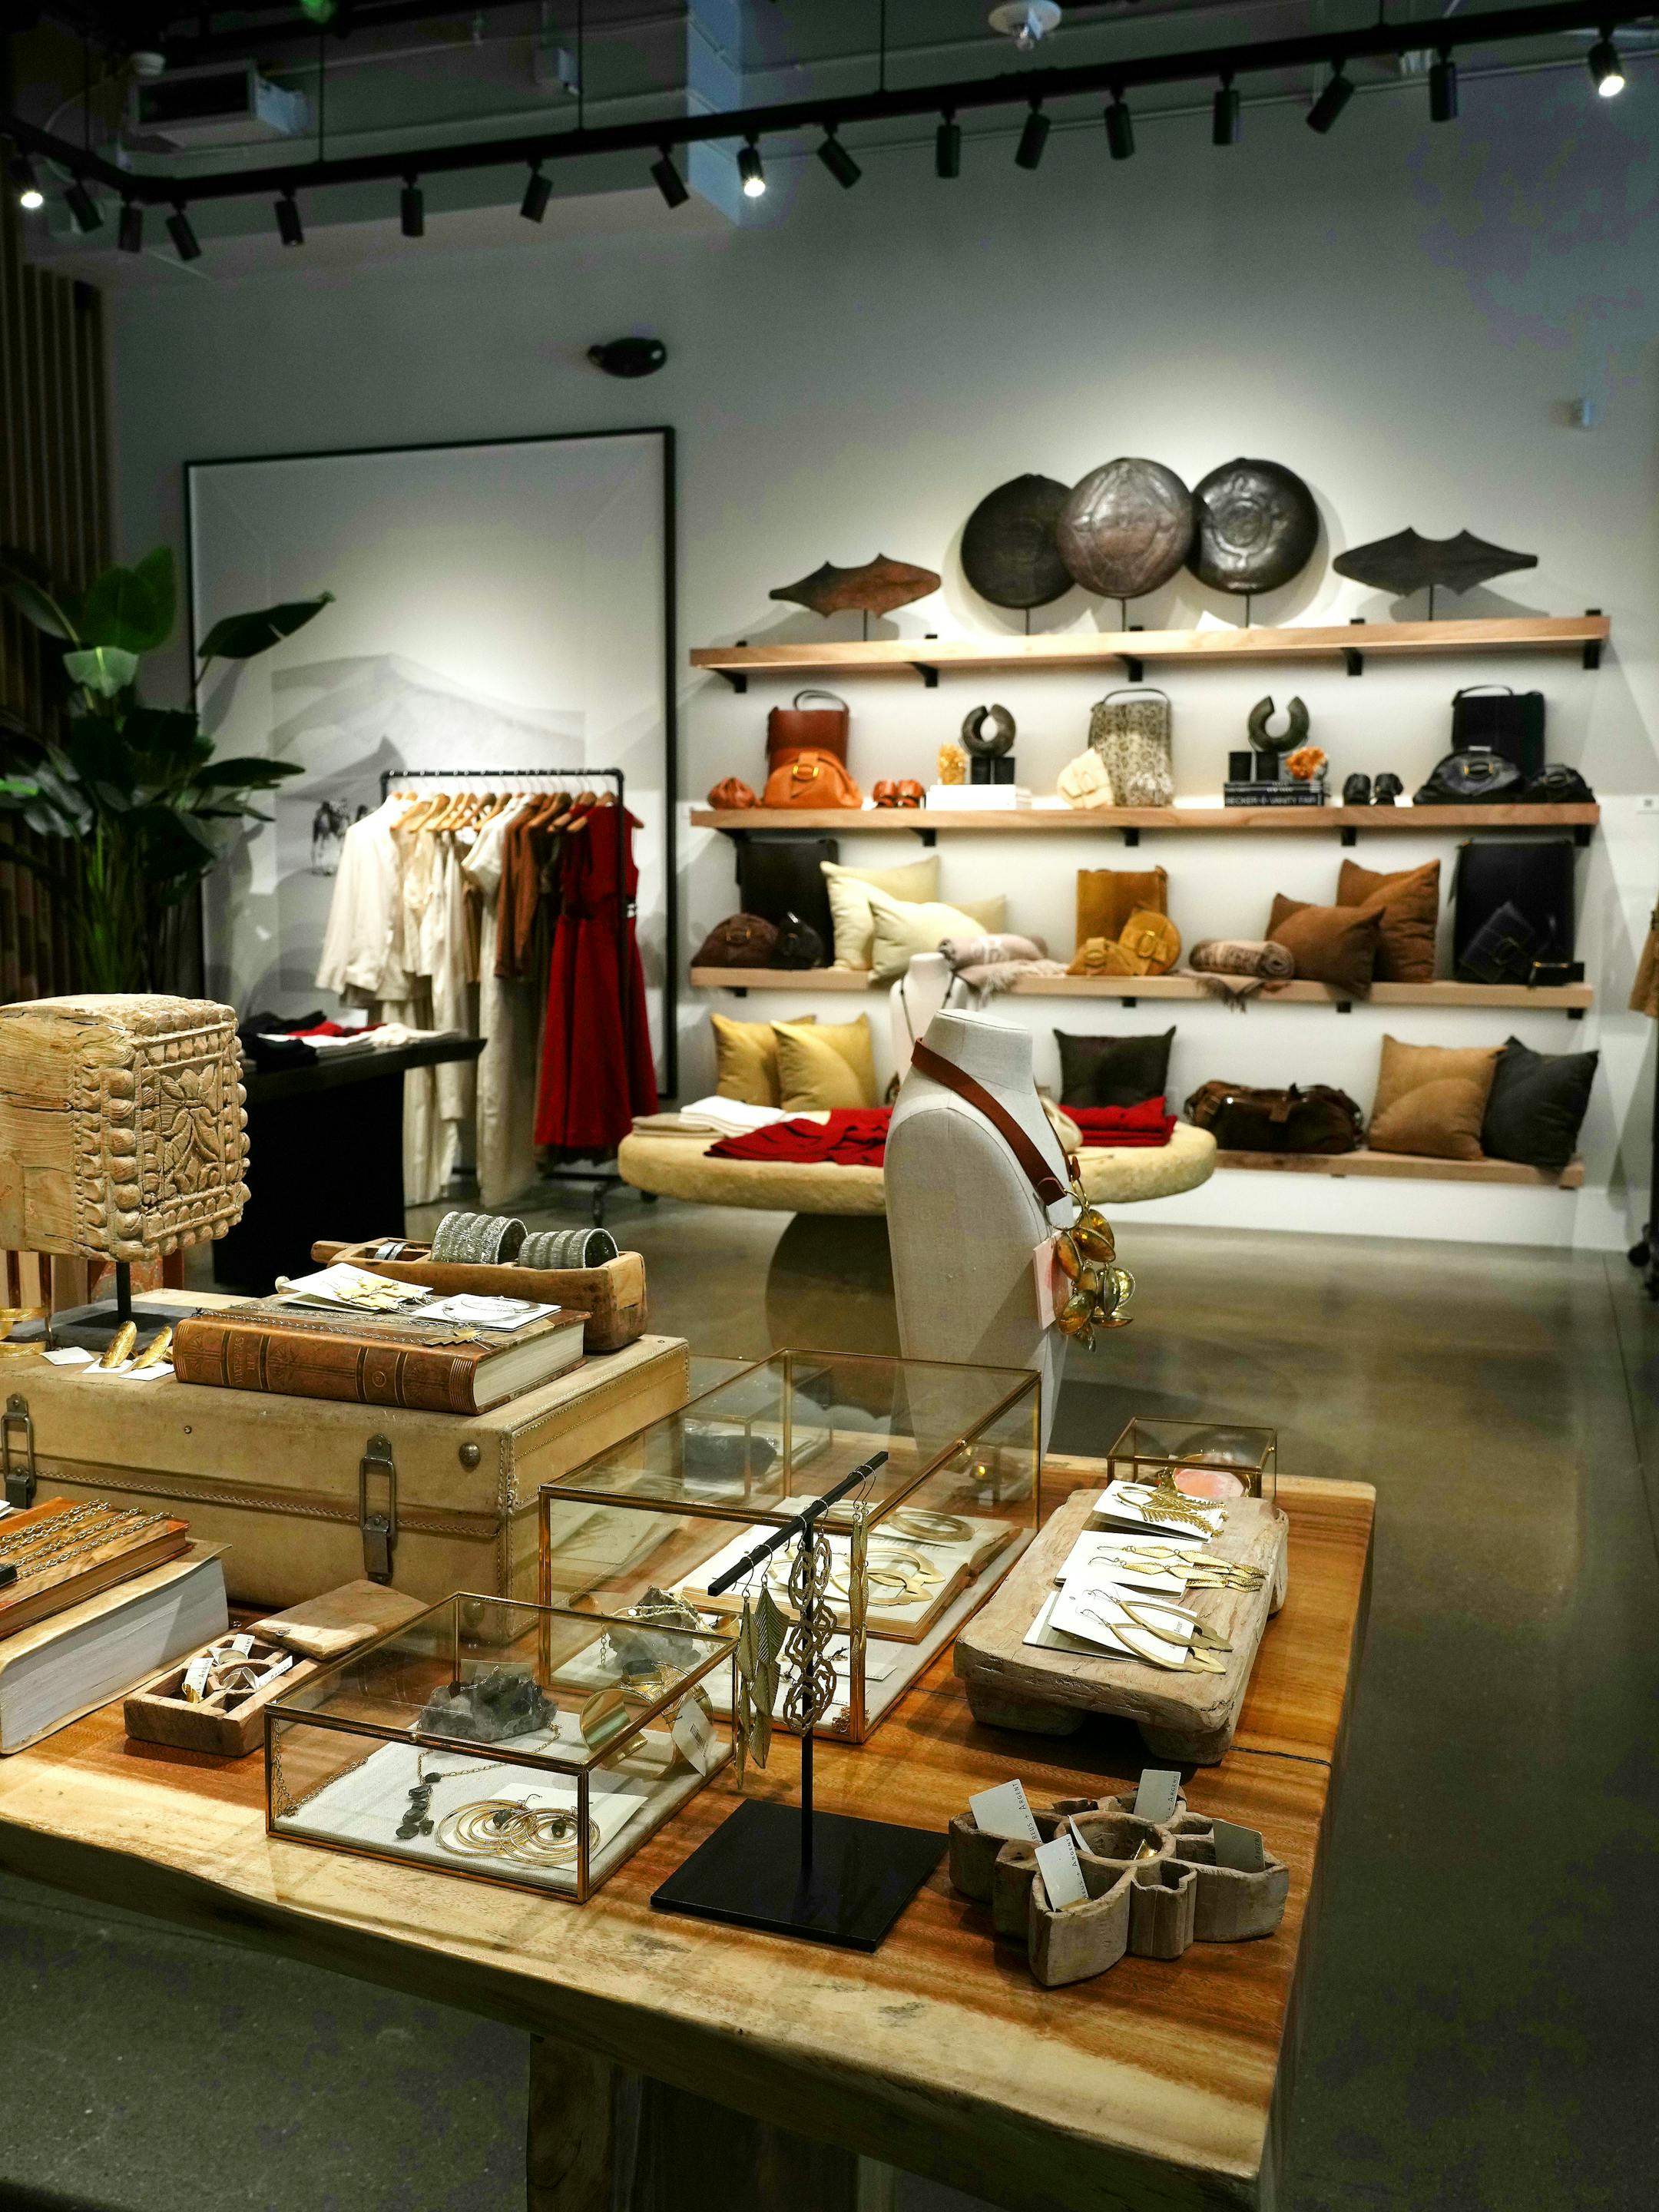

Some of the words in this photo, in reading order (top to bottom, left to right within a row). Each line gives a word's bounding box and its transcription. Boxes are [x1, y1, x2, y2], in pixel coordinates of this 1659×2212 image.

[1012, 1783, 1026, 1810] ARGENT
[1167, 1776, 1177, 1803] ARGENT
[1066, 1838, 1078, 1866] ARGENT
